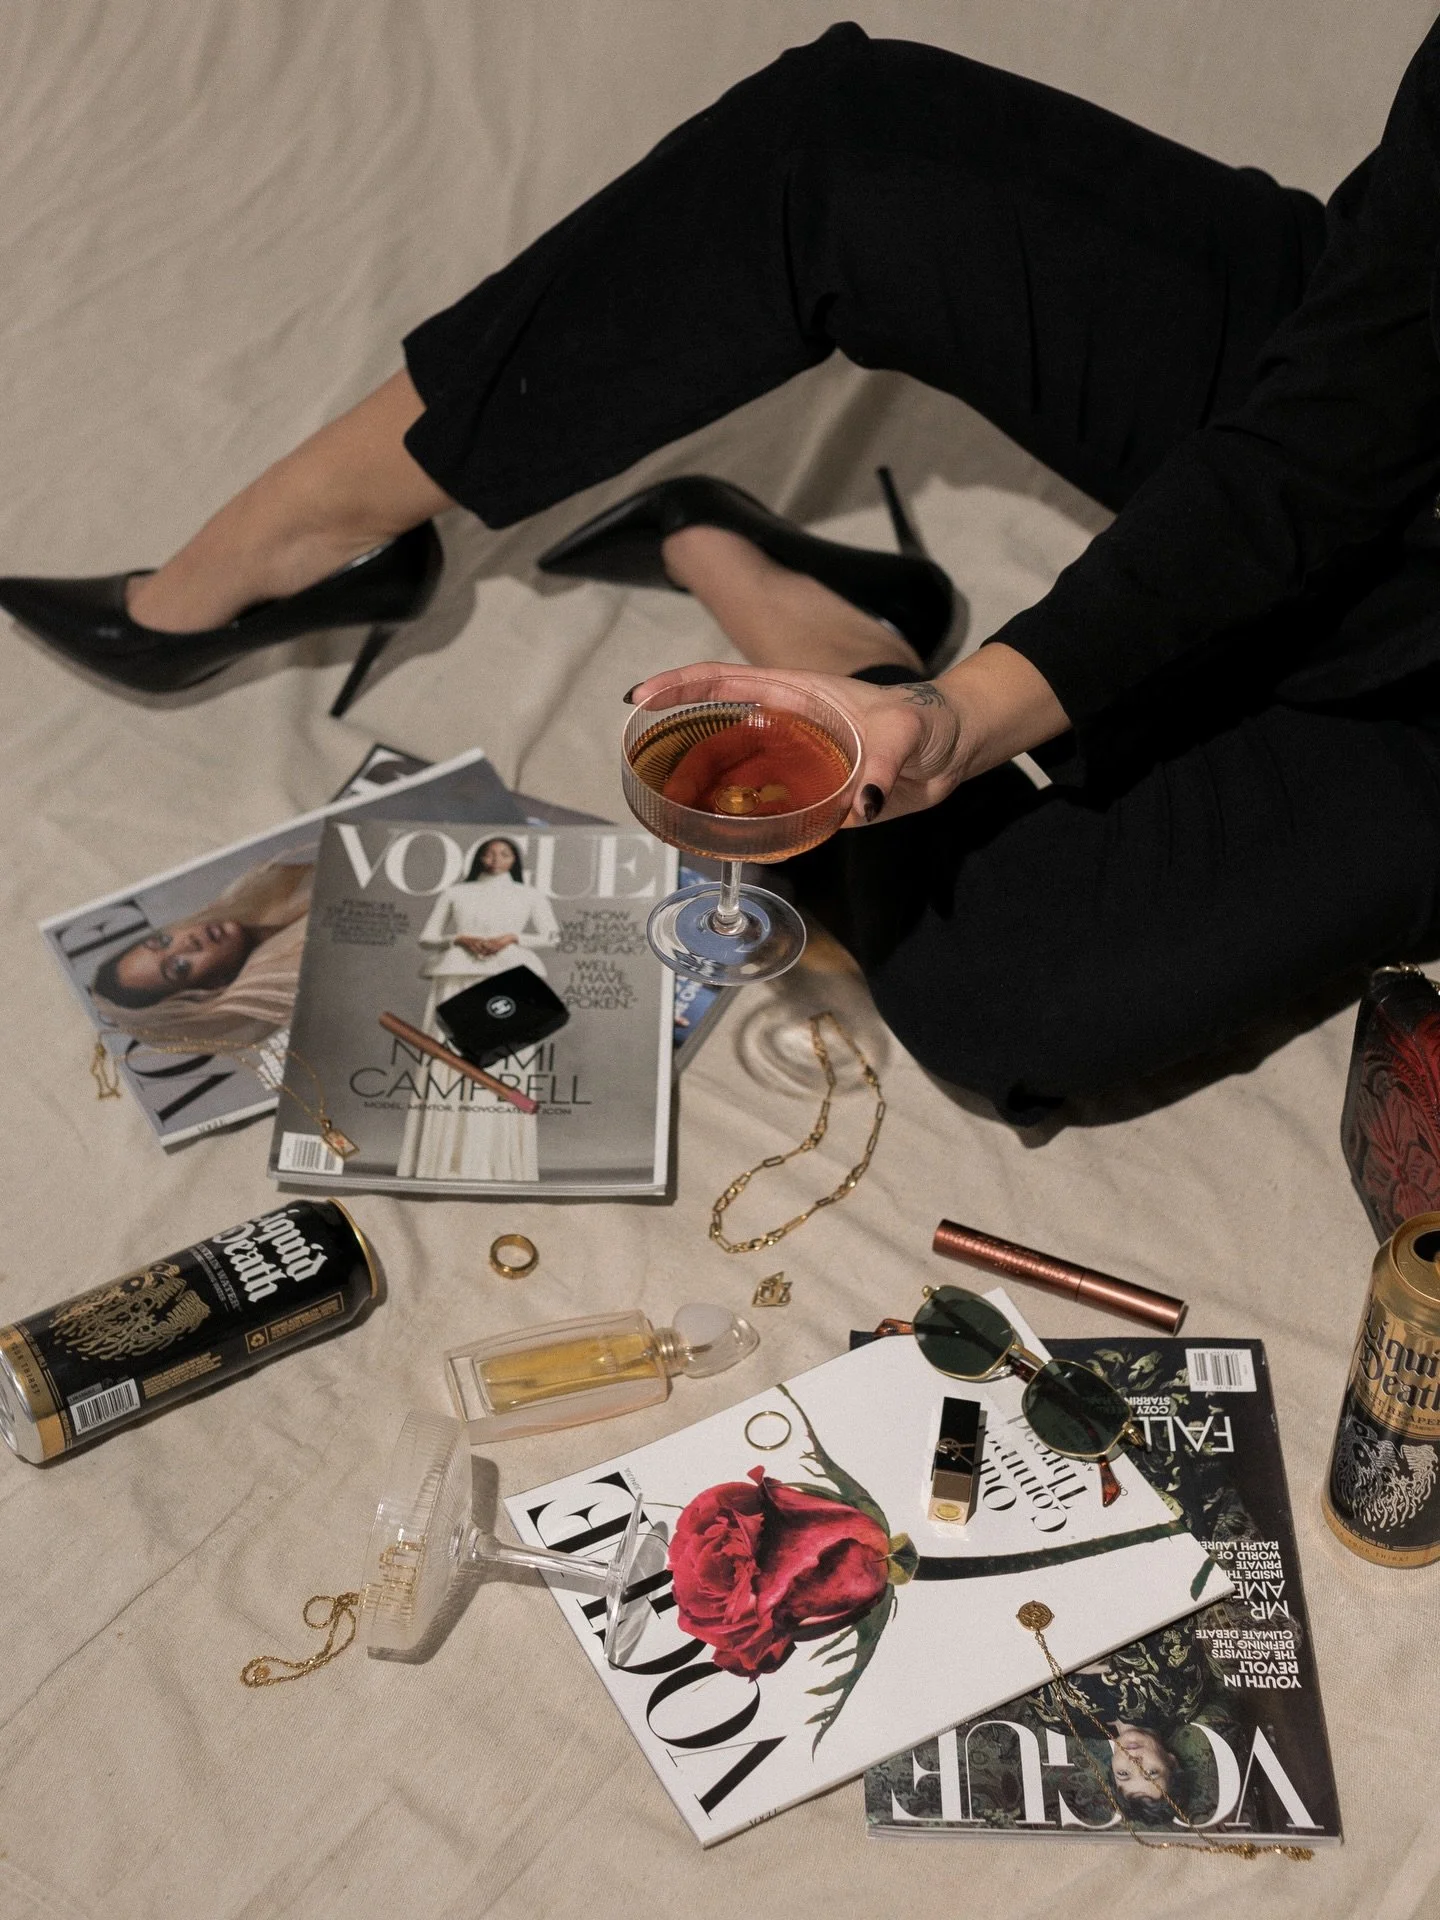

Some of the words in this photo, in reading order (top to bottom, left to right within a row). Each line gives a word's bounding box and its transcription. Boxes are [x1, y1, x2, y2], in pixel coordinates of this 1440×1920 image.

[54, 899, 237, 1122] VOE
[391, 1037, 555, 1072] NMI
[349, 1067, 593, 1105] CAMPBELL
[256, 1209, 328, 1282] iquid
[213, 1222, 288, 1303] Death
[1363, 1302, 1440, 1379] Liqui
[1123, 1396, 1171, 1405] STARRIN
[1136, 1406, 1169, 1415] COZY
[1131, 1416, 1235, 1452] FALL
[977, 1425, 1068, 1532] Comm
[1199, 1541, 1237, 1550] LAURE
[1241, 1541, 1280, 1550] RALPH
[1217, 1551, 1234, 1560] OF
[1237, 1551, 1281, 1560] WORLD
[1235, 1560, 1282, 1570] PRIVATE
[1245, 1570, 1284, 1579] INSIDE
[1233, 1580, 1286, 1599] AME
[1244, 1600, 1290, 1620] MR.
[1195, 1629, 1239, 1639] DEBATE
[1242, 1630, 1293, 1640] CLIMATE
[526, 1471, 787, 1820] VOGUE
[1212, 1640, 1235, 1649] THE
[1237, 1640, 1295, 1650] DEFINING
[1212, 1649, 1270, 1660] ACTIVISTS
[1275, 1651, 1297, 1660] THE
[1239, 1661, 1299, 1674] REVOLT
[1223, 1673, 1241, 1687] IN
[1246, 1673, 1302, 1689] YOUTH
[890, 1719, 1325, 1830] VOGUE
